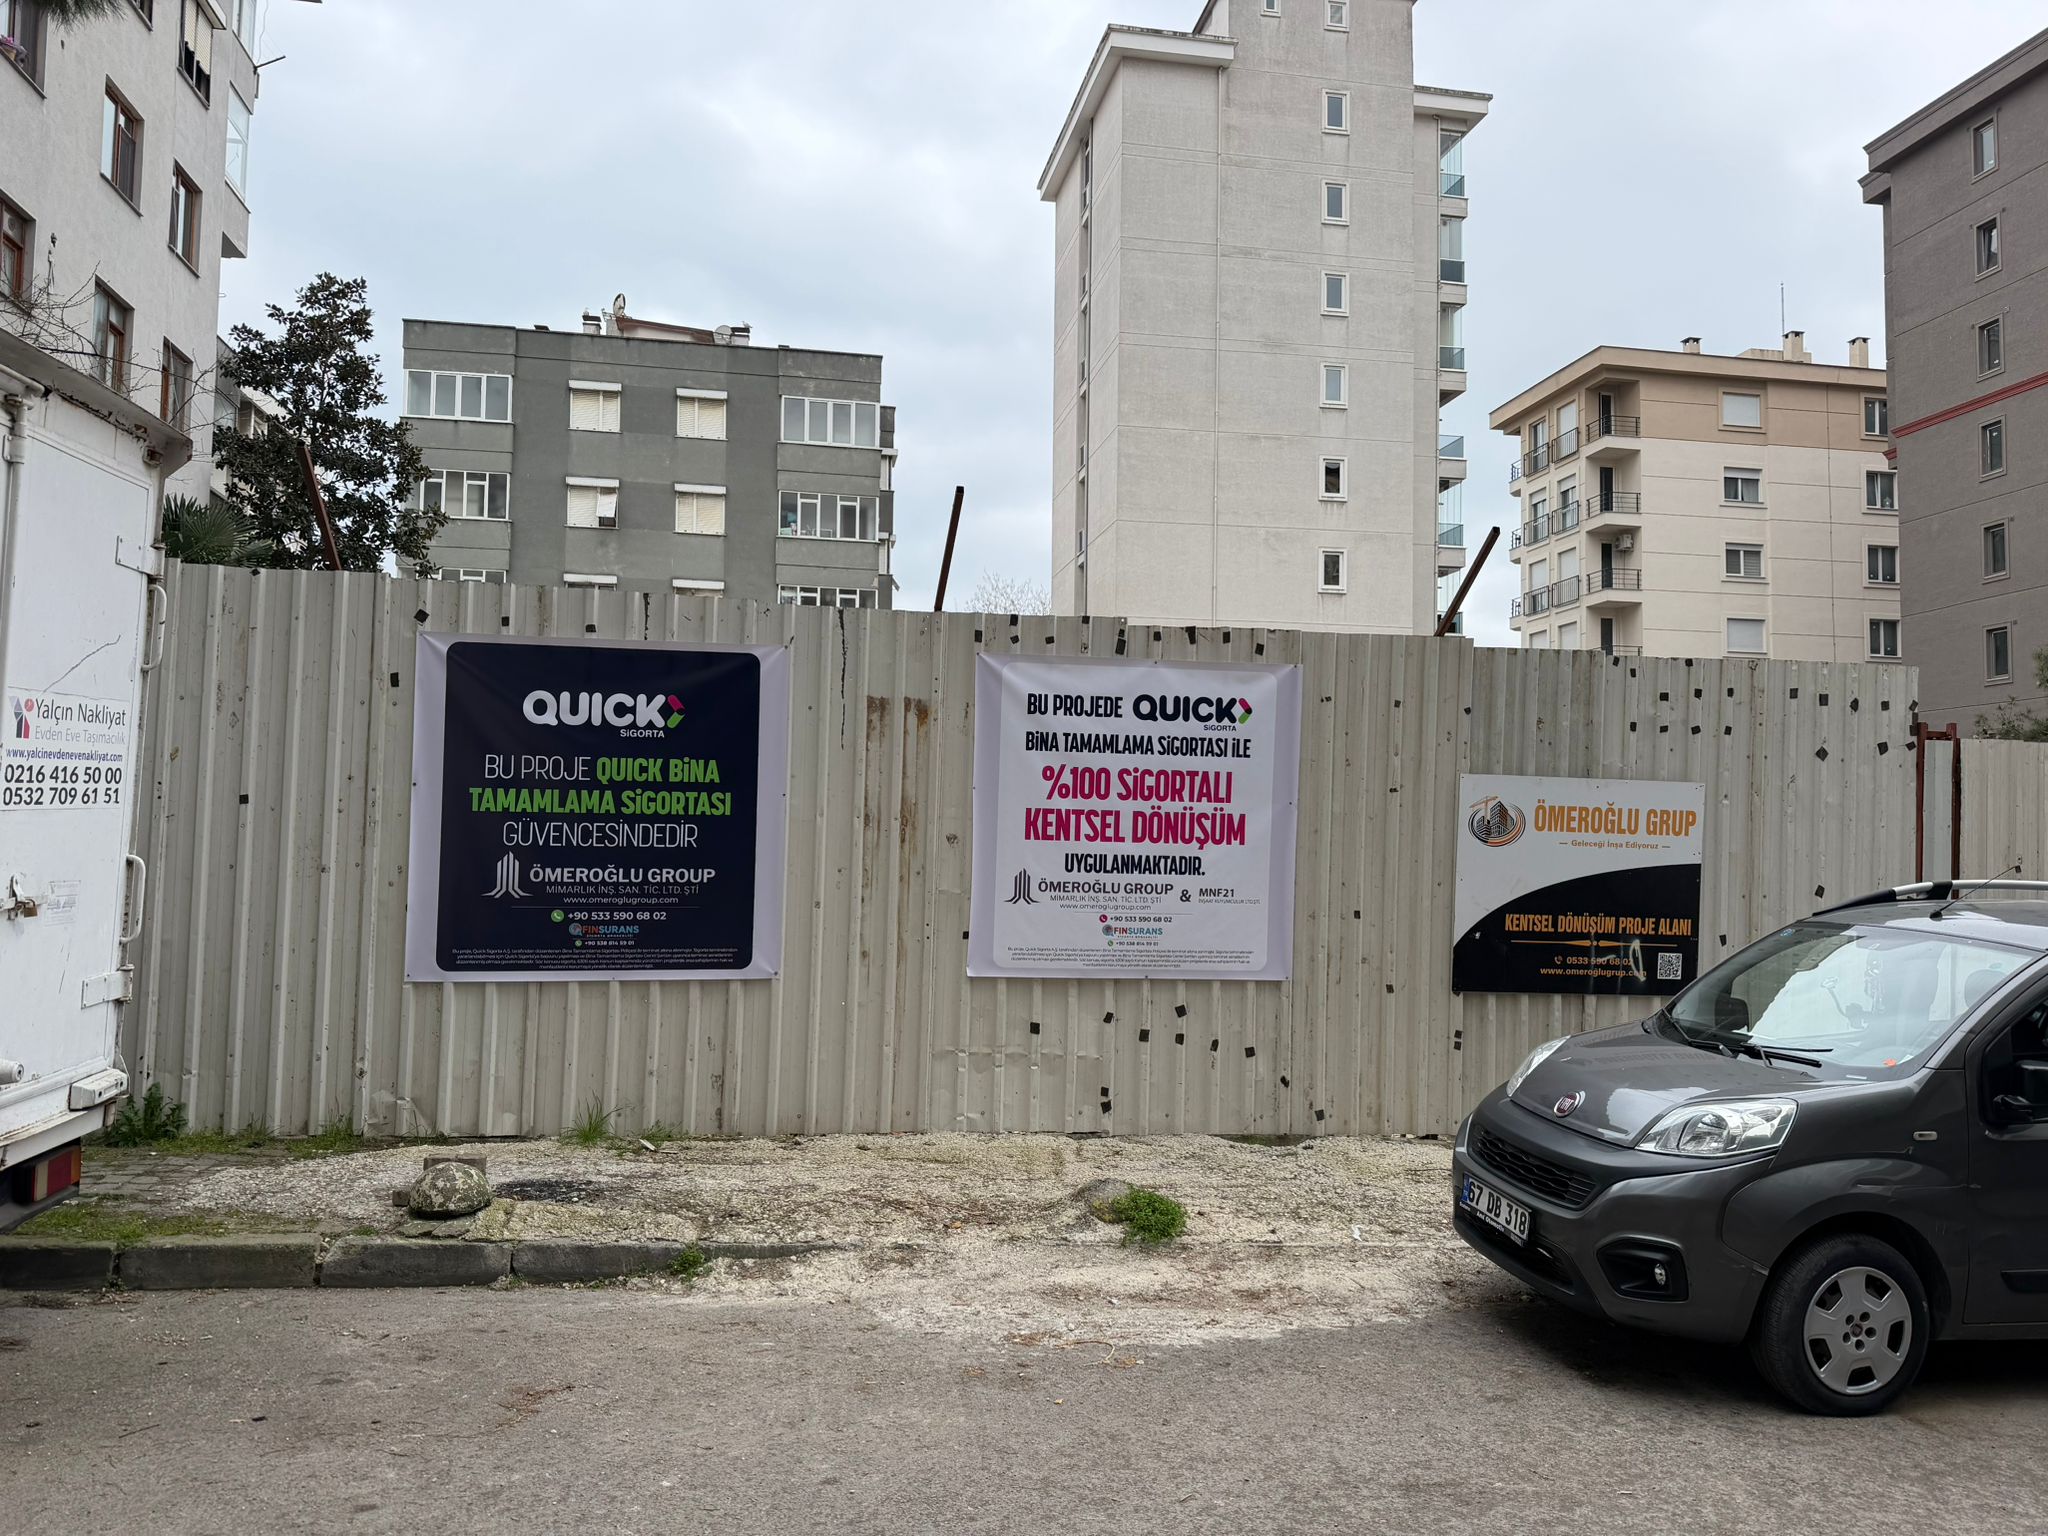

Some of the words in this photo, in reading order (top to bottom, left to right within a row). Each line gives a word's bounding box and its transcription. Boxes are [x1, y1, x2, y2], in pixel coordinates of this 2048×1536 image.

[35, 698, 73, 725] Yalçın
[78, 703, 126, 729] Nakliyat
[522, 689, 666, 727] QUICK
[1027, 693, 1048, 715] BU
[1053, 694, 1124, 718] PROJEDE
[1132, 694, 1238, 724] QUICK
[35, 726, 64, 740] Evden
[66, 728, 81, 741] Eve
[83, 730, 125, 746] Taşımacılık
[1063, 733, 1154, 755] TAMAMLAMA
[6, 747, 122, 763] www.yalcinevdenevenakliyat.com
[5, 764, 45, 783] 0216
[50, 766, 79, 783] 416
[83, 767, 102, 784] 50
[105, 767, 122, 784] 00
[485, 754, 514, 779] BU
[521, 755, 591, 781] PROJE
[596, 758, 664, 784] QUICK
[1042, 764, 1110, 801] %100
[3, 787, 44, 805] 0532
[49, 787, 77, 804] 709
[81, 788, 97, 804] 61
[103, 788, 120, 804] 51
[469, 787, 616, 814] TAMAMLAMA
[1024, 808, 1125, 843] KENTSEL
[1132, 805, 1246, 850] DÖNÜŞÜM
[1534, 799, 1639, 835] ÖMEROĞLU
[1646, 809, 1697, 836] GRUP
[503, 818, 697, 848] GÜVENCESİNDEDİR
[1626, 841, 1659, 850] Ediyoruz
[530, 864, 643, 883] ÖMEROĞLU
[648, 869, 716, 883] GROUP
[1065, 853, 1205, 876] UYGULANMAKTADIR.
[546, 885, 596, 894] MİMARLIK
[618, 886, 640, 894] SAN.
[564, 896, 678, 905] www.omeroglugroup.com
[1038, 878, 1121, 894] ÖMEROĞLU
[1124, 882, 1174, 895] GROUP
[1179, 889, 1191, 902] &
[1199, 888, 1235, 898] MNF21
[568, 912, 588, 920] +90
[591, 912, 610, 920] 533
[613, 912, 633, 920] 590
[637, 912, 650, 920] 68
[653, 912, 667, 920] 02
[1060, 903, 1151, 911] www.omeroglugroup.com
[582, 925, 639, 933] FINSURANS
[1114, 927, 1163, 935] FINSURANS
[1505, 913, 1554, 932] KENTSEL
[1558, 912, 1615, 935] DÖNÜŞÜM
[1619, 918, 1656, 935] PROJE
[1659, 918, 1691, 936] ALANI
[1469, 1181, 1483, 1206] 67
[1487, 1192, 1502, 1218] DB
[1505, 1202, 1527, 1235] 318
